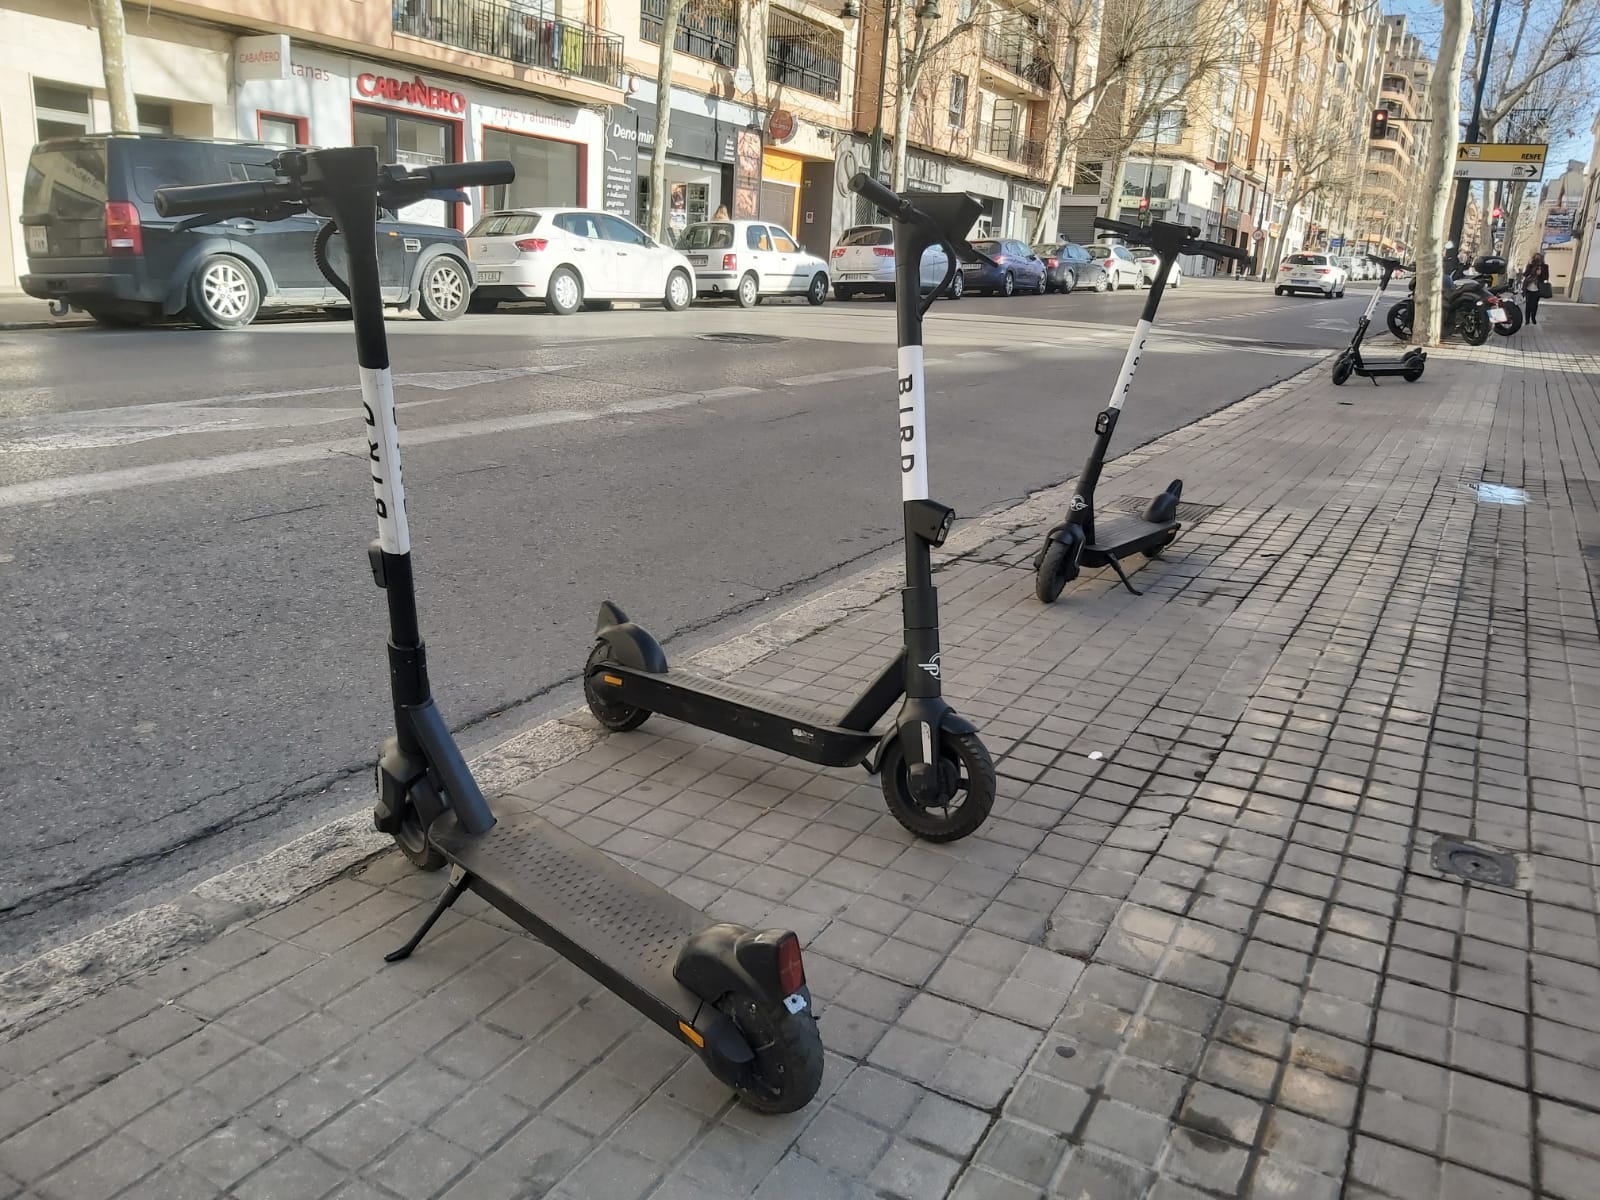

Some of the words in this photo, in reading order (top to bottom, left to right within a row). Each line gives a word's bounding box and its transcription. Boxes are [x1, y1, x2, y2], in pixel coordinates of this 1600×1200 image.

[239, 49, 280, 64] CABAÑERO
[290, 61, 330, 81] tanas
[356, 73, 466, 113] CABAÑERO
[501, 106, 519, 119] pvc
[521, 109, 527, 124] y
[529, 108, 571, 129] aluminio
[613, 123, 674, 148] Denomins
[1521, 153, 1542, 161] RENFE
[898, 373, 915, 473] BIRD
